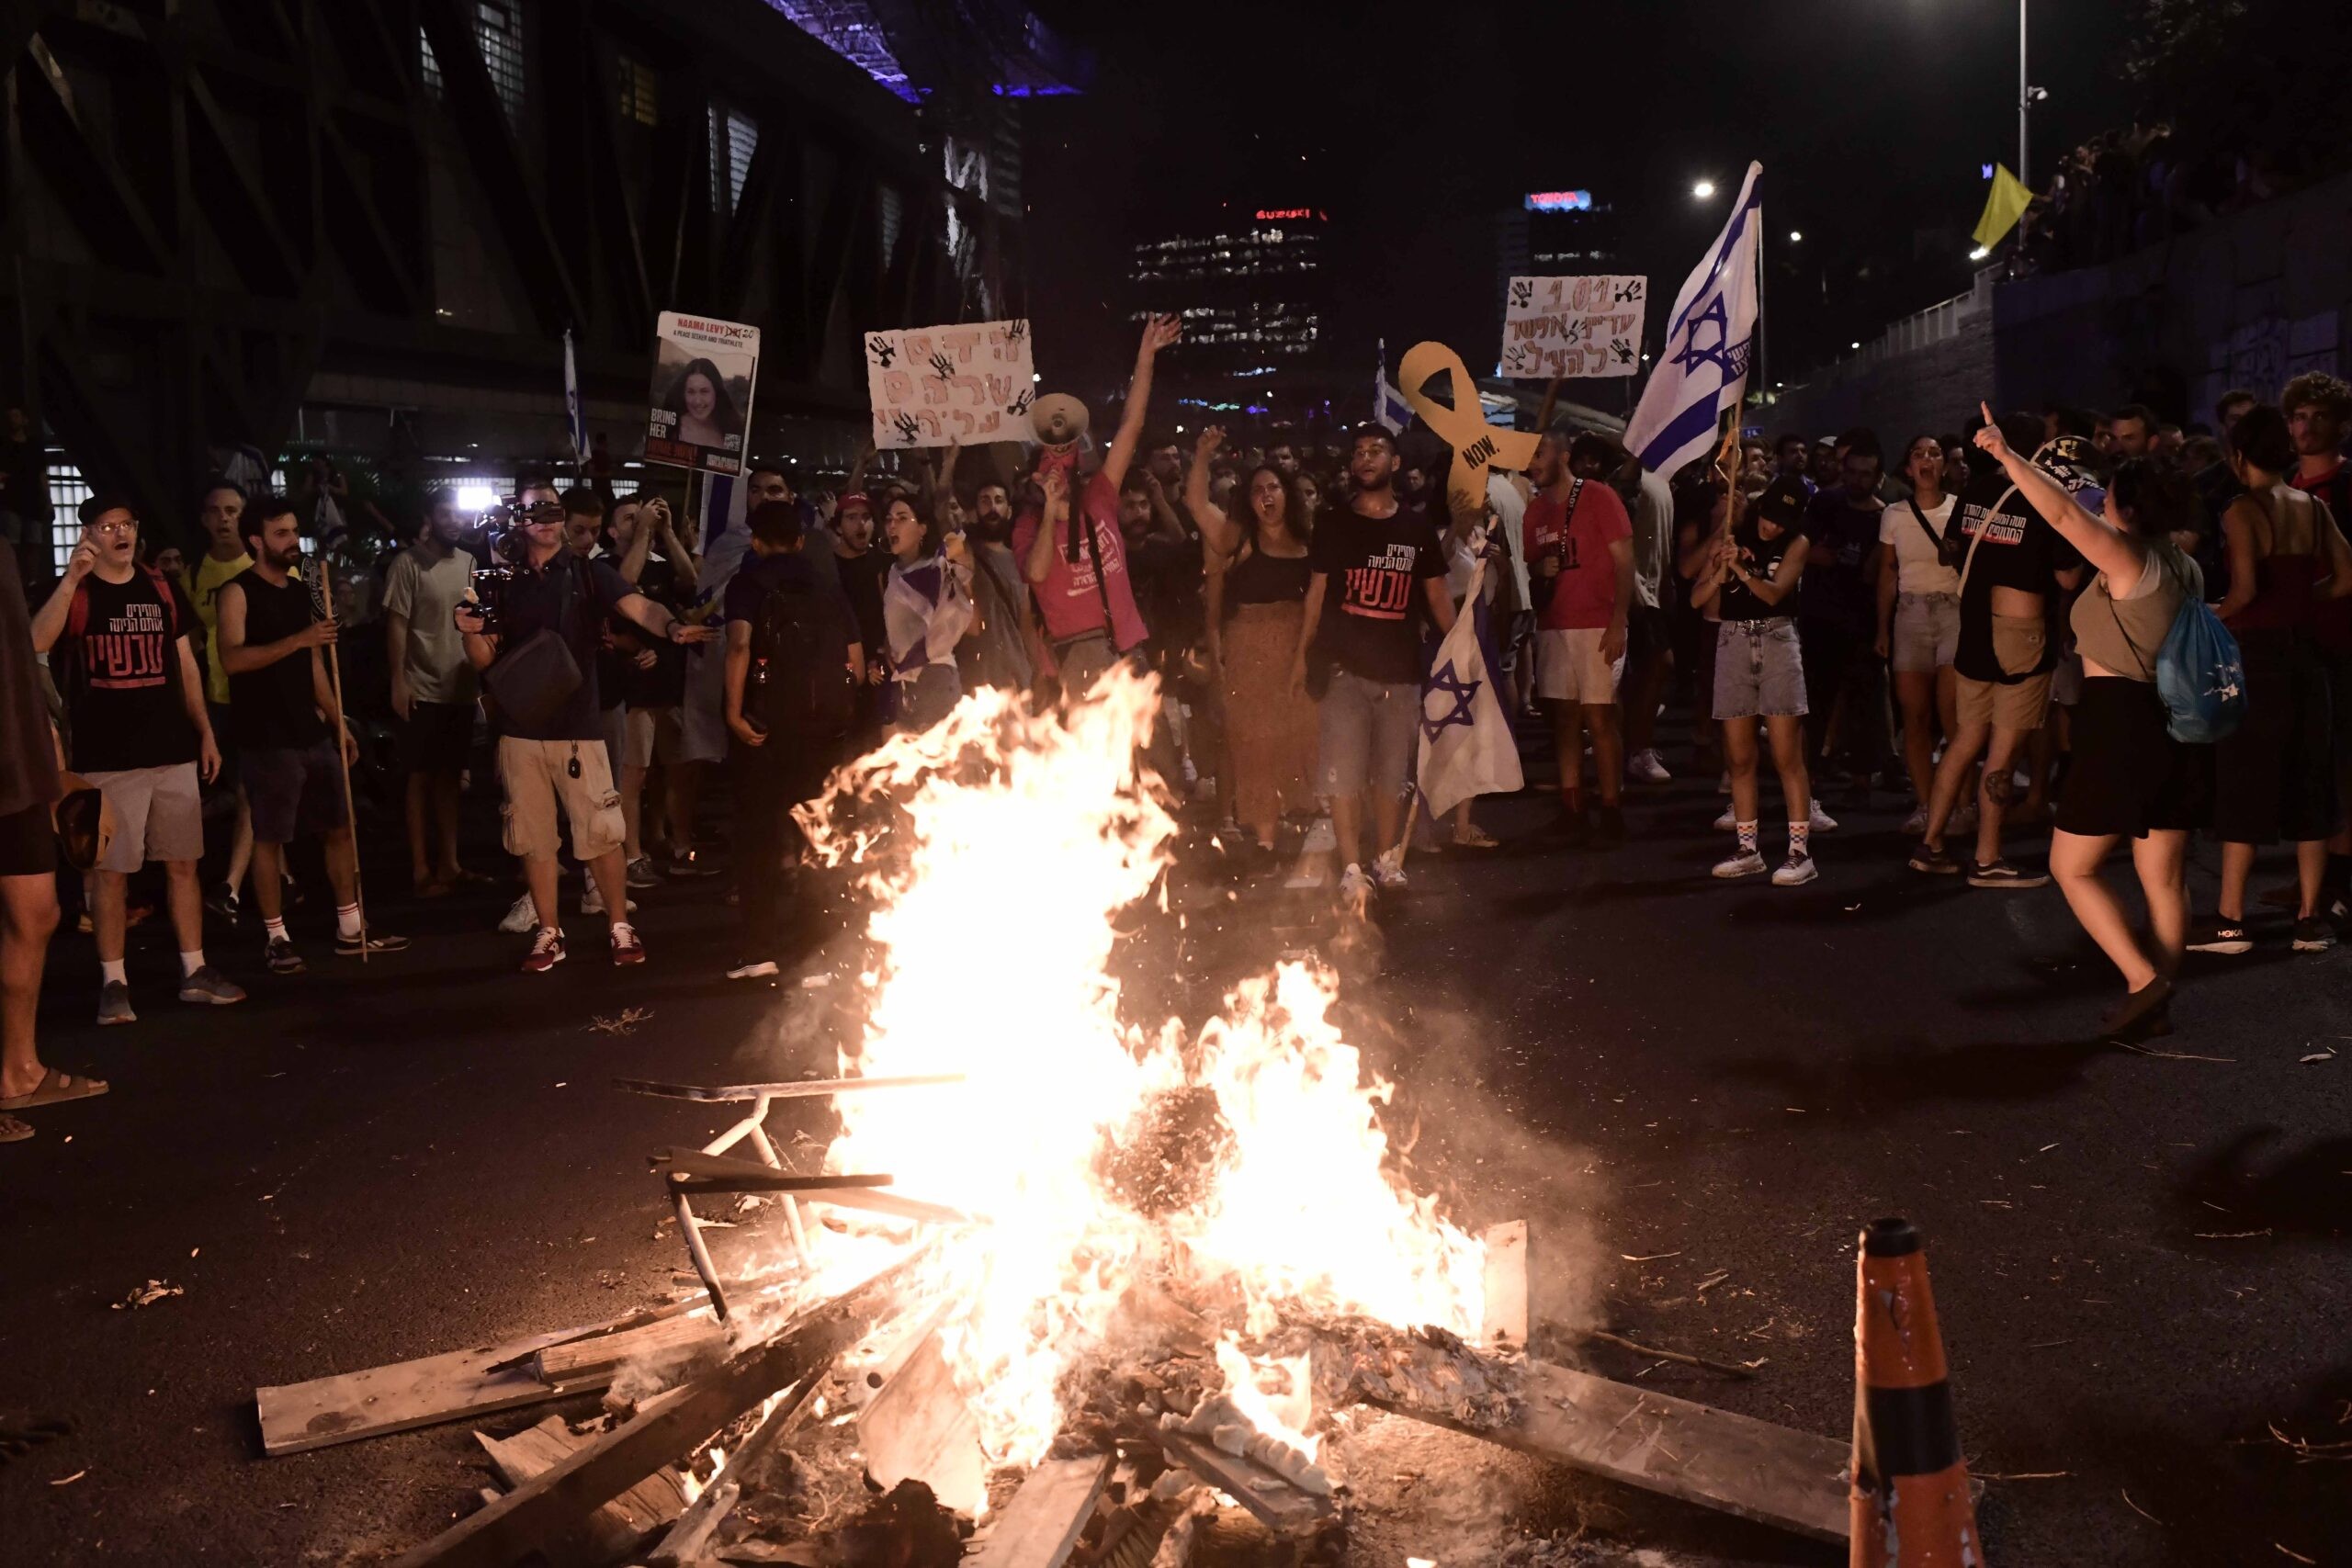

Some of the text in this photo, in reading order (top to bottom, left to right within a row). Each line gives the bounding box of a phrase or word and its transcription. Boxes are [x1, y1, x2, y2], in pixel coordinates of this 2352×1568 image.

[1543, 277, 1615, 313] 101
[677, 318, 705, 333] NAAMA
[706, 321, 725, 335] LEVY
[651, 408, 676, 425] BRING
[650, 423, 666, 438] HER
[1462, 434, 1500, 470] NOW.
[1344, 568, 1412, 610] עכשיו
[126, 604, 162, 617] מחזירים
[109, 617, 164, 632] אותם הביתה
[85, 634, 164, 676] עכשיו
